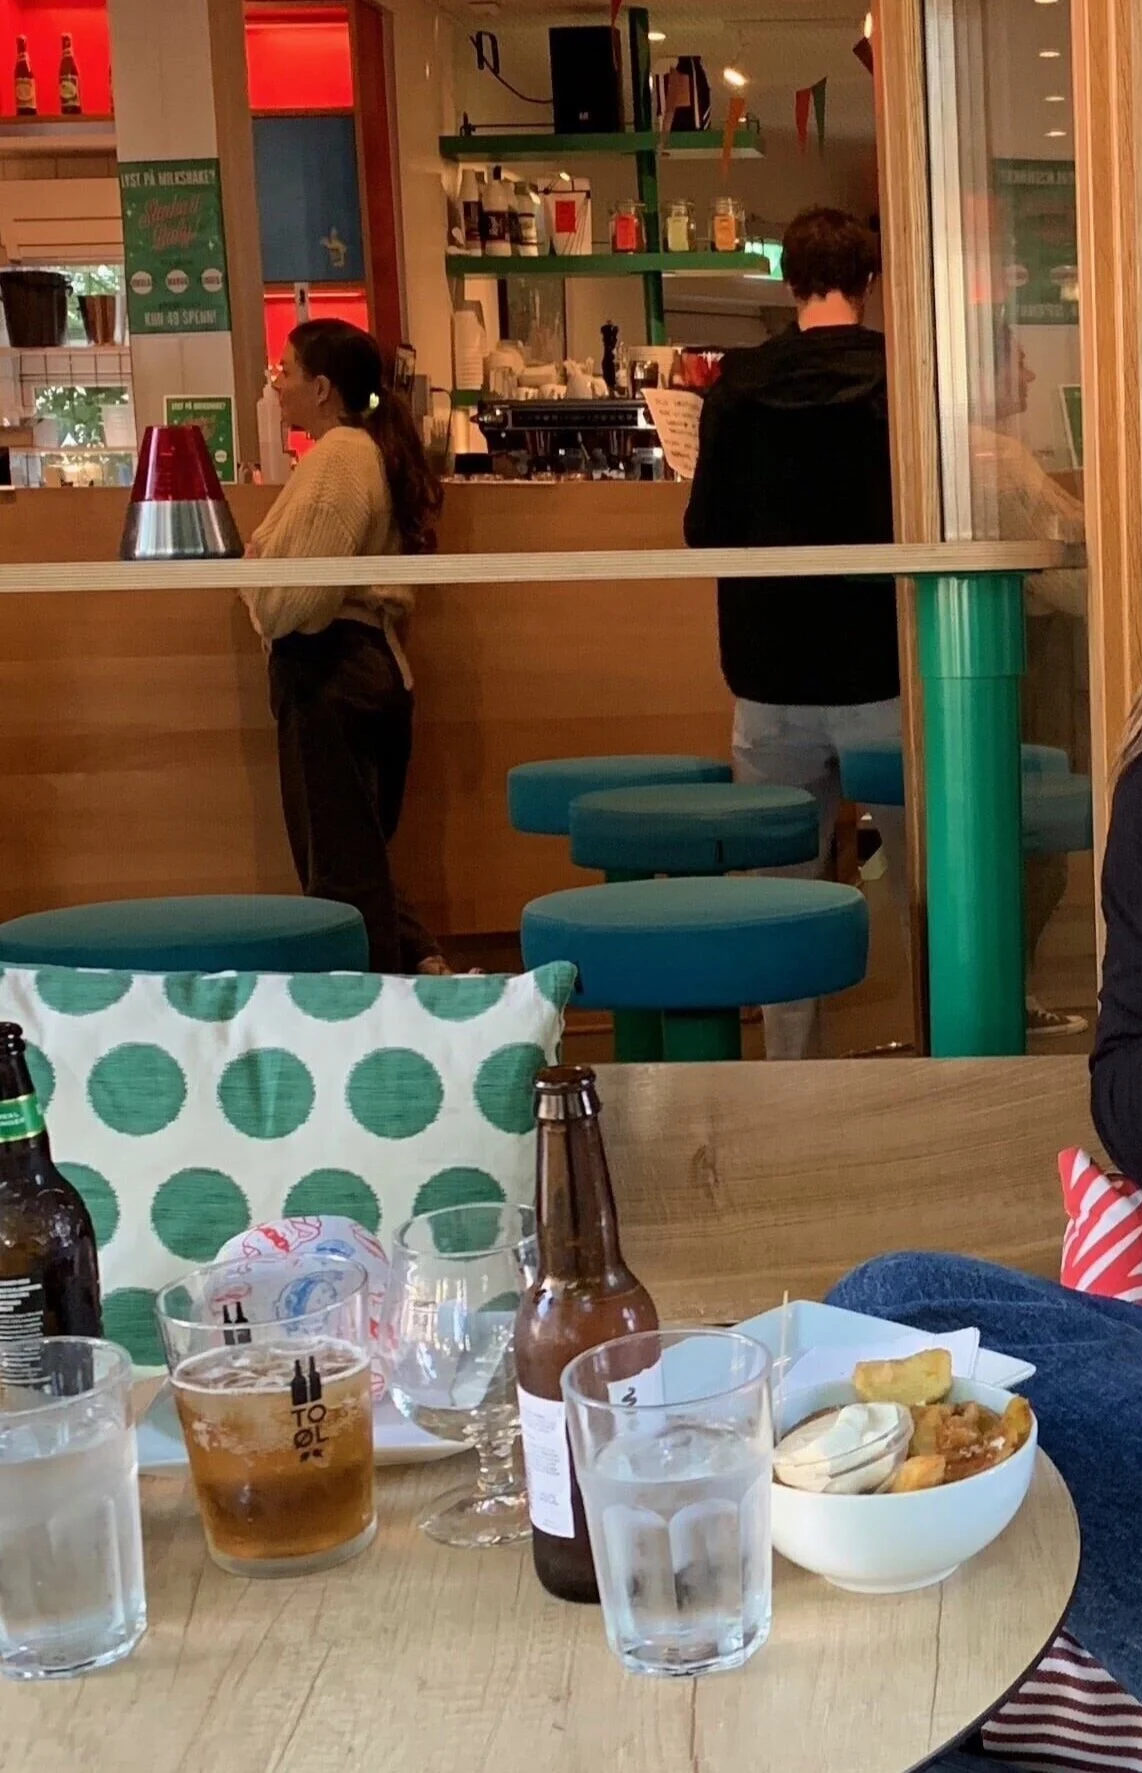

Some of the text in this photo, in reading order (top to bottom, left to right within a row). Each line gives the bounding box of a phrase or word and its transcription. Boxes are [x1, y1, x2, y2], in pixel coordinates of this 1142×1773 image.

[143, 168, 156, 186] PÅ
[168, 310, 180, 326] 49
[291, 1404, 327, 1427] TO
[293, 1426, 330, 1450] ØL
